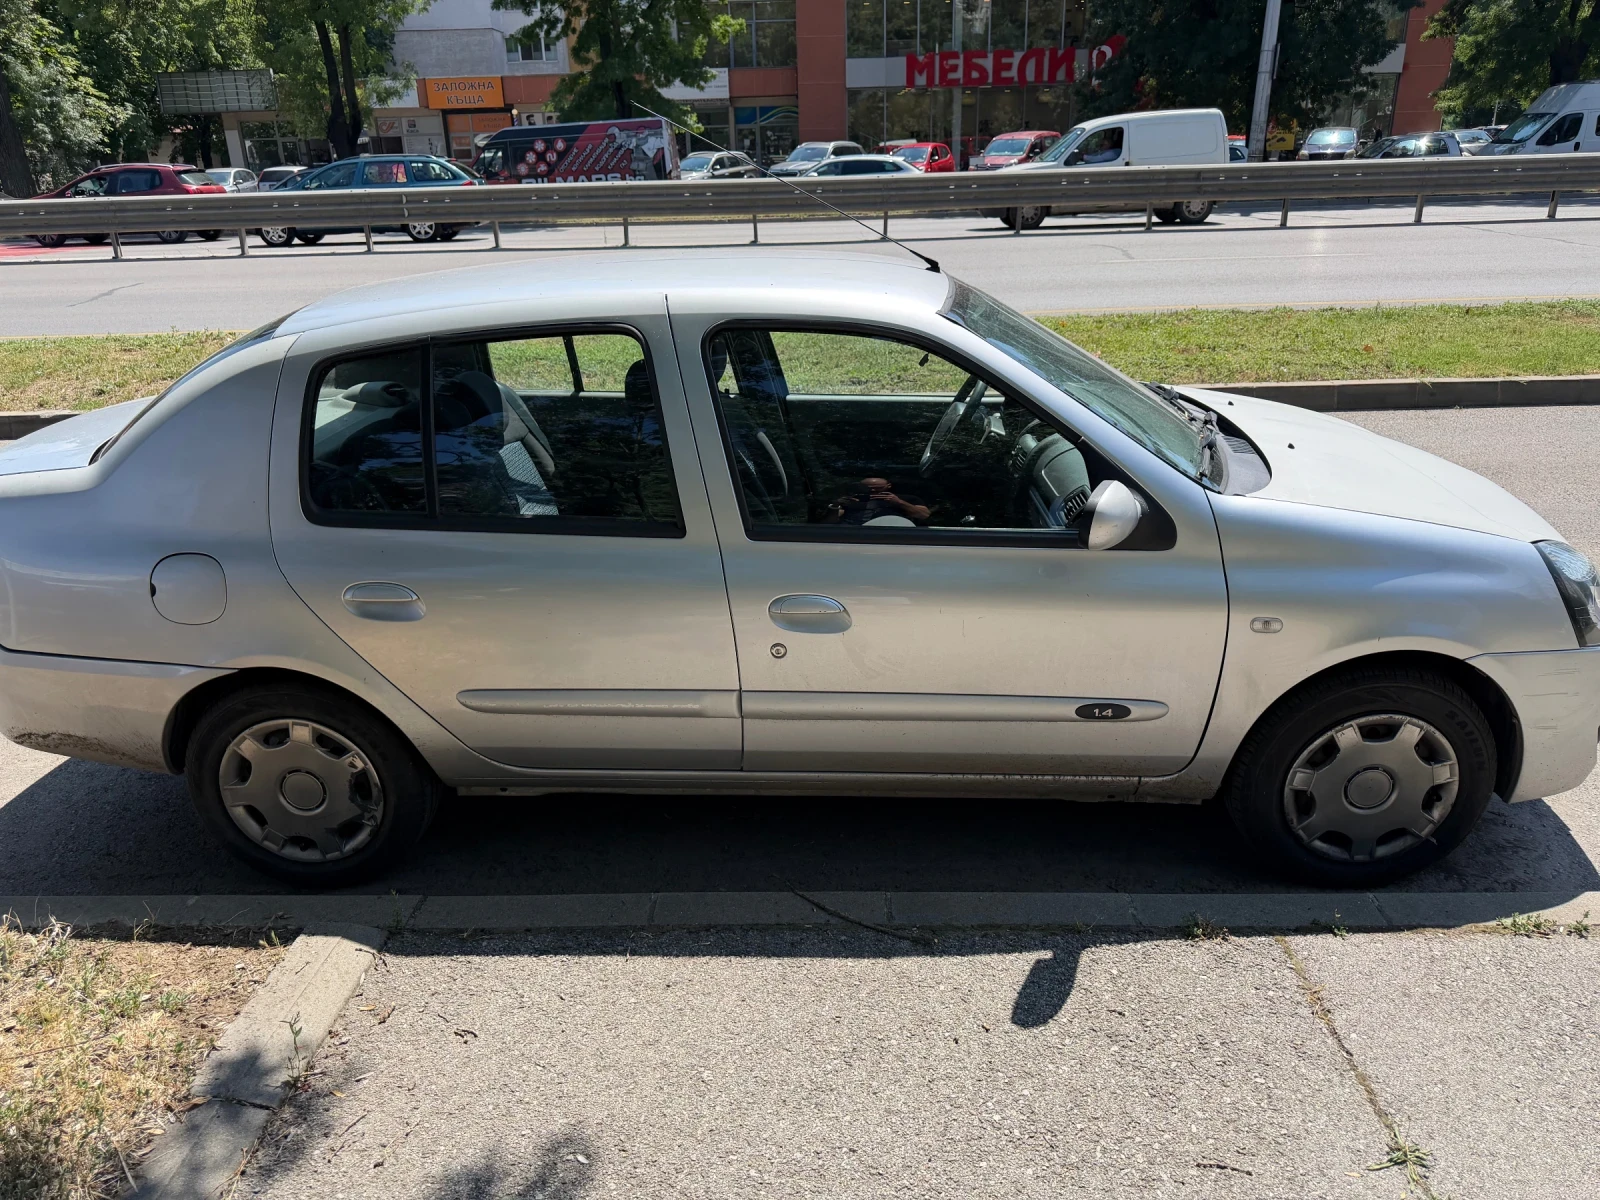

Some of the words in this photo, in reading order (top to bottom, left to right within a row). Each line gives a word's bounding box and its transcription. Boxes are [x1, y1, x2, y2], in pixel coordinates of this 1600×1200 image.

[905, 46, 1077, 88] МЕБЕЛИ
[433, 81, 495, 92] ЗАЛОЖНА
[446, 95, 485, 105] КЪЩА
[619, 159, 629, 170] ГАЗ
[1093, 708, 1114, 717] 1.4
